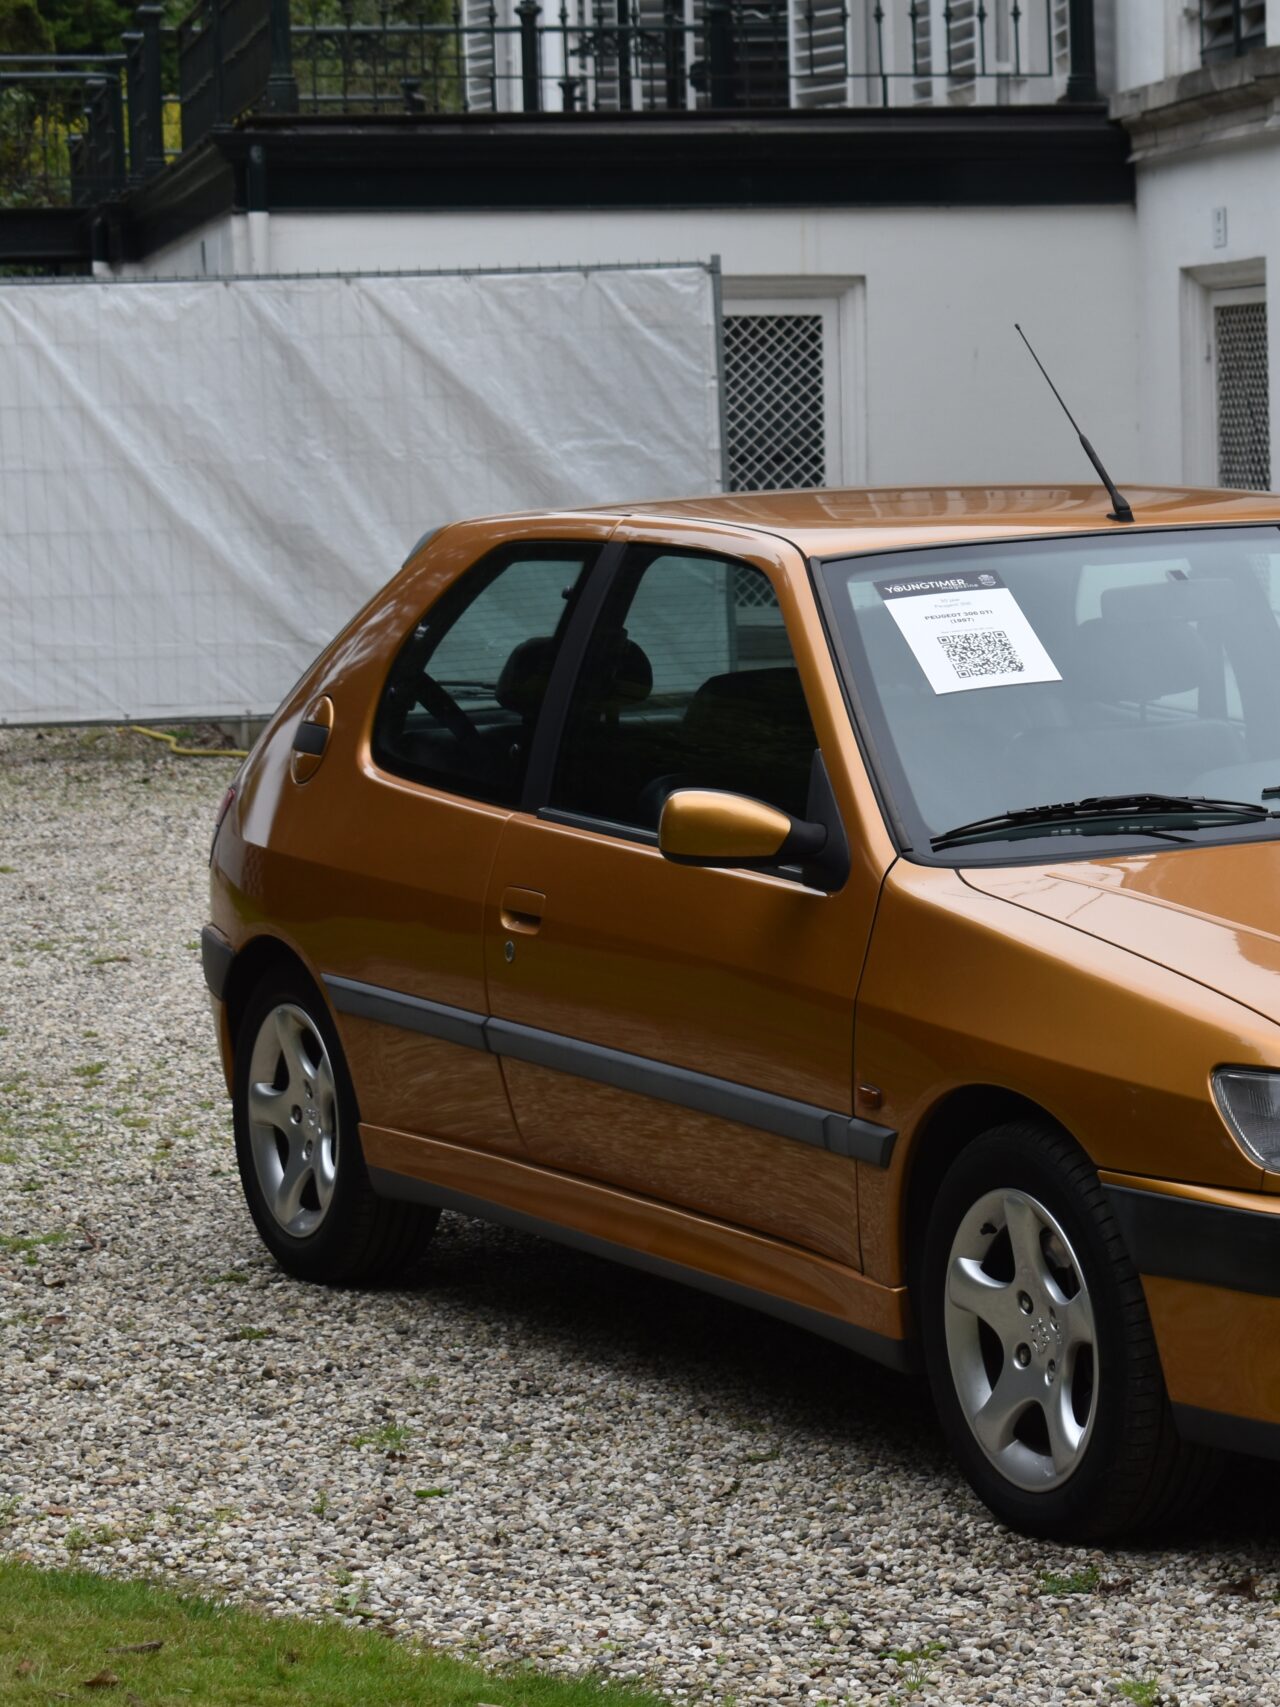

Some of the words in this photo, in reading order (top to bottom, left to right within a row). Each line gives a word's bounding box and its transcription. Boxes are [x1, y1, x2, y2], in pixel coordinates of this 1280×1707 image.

[884, 579, 965, 594] YOUNGTIMER
[941, 583, 979, 591] magazine
[924, 612, 961, 620] PEUGEOT
